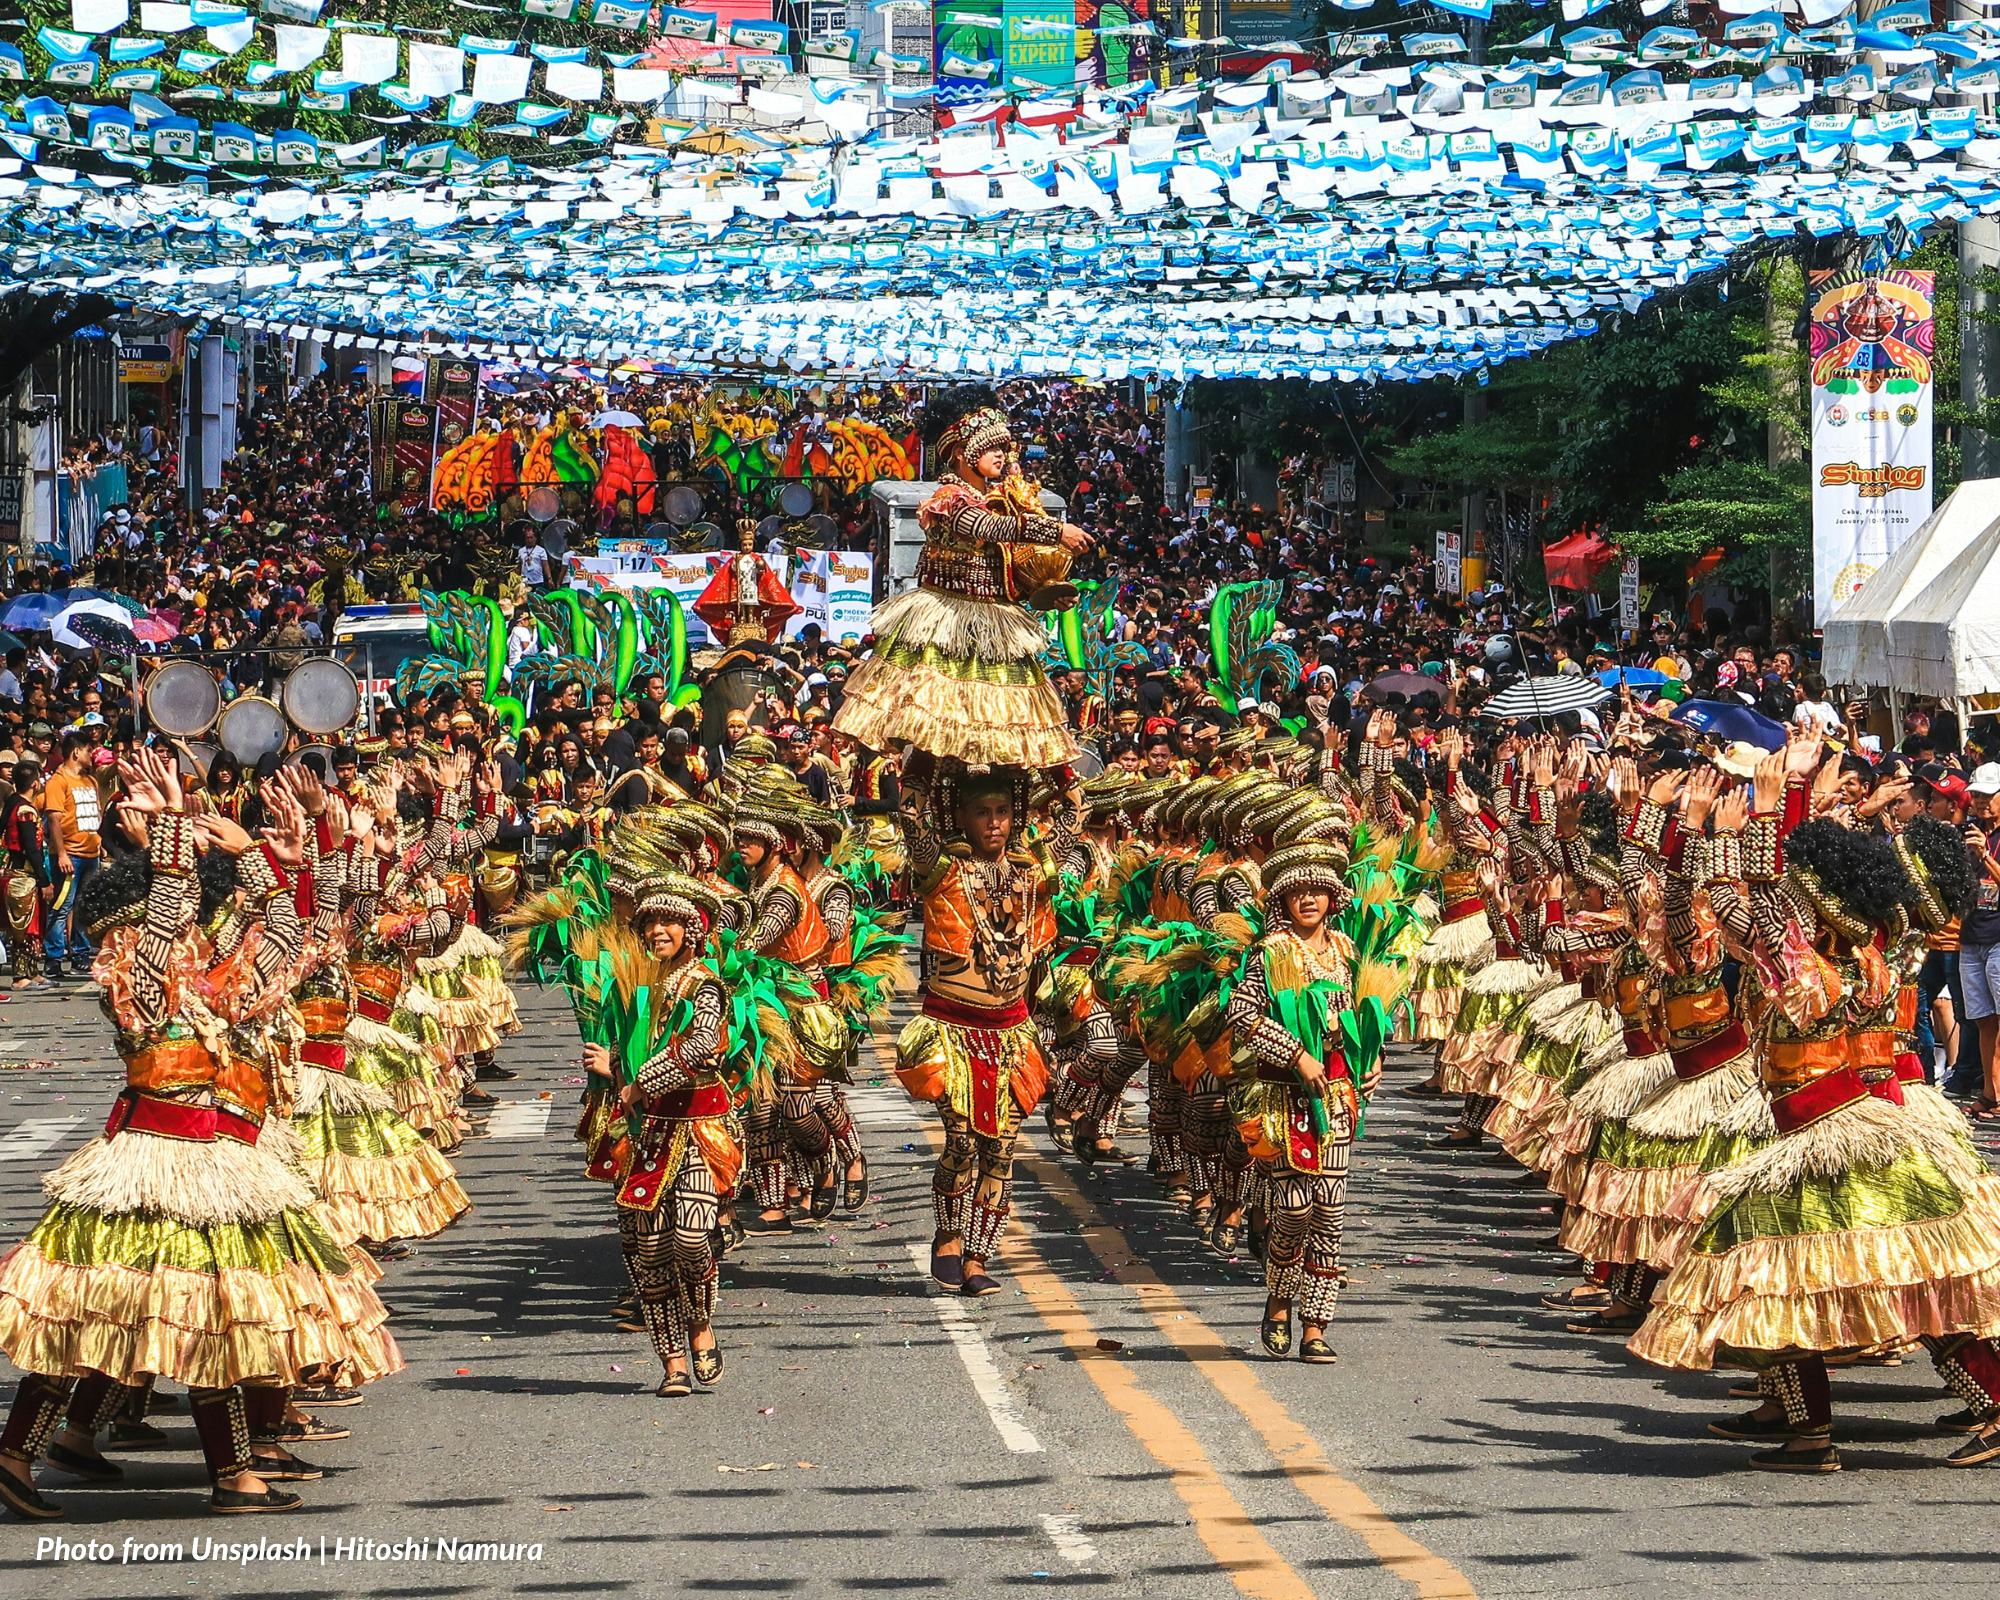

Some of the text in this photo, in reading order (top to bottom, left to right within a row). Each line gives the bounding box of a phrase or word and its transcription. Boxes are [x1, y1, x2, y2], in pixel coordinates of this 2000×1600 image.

[603, 5, 640, 18] Smart
[1010, 14, 1067, 40] BEACH
[741, 30, 779, 40] Smart
[1010, 43, 1067, 65] EXPERT
[57, 63, 90, 74] Smart
[1881, 114, 1914, 128] Smart
[1934, 110, 1968, 119] Smart
[38, 116, 67, 131] Smart
[98, 126, 126, 139] Smart
[158, 131, 191, 143] Smart
[217, 137, 249, 150] Smart
[1755, 135, 1786, 146] Smart
[280, 143, 312, 155] Smart
[1392, 144, 1421, 157] Smart
[1020, 164, 1044, 176] mart
[1092, 164, 1107, 175] art
[1724, 223, 1748, 232] Smart
[119, 348, 141, 359] ATM
[384, 404, 398, 491] PREMIUM HOTDOG
[1820, 461, 1926, 492] Sinulog
[0, 479, 21, 498] EY
[1858, 484, 1887, 497] 2020
[1841, 508, 1903, 516] Cebu, Philippines
[1835, 517, 1864, 526] January
[612, 557, 646, 570] 1-17
[661, 565, 708, 579] Sinulo
